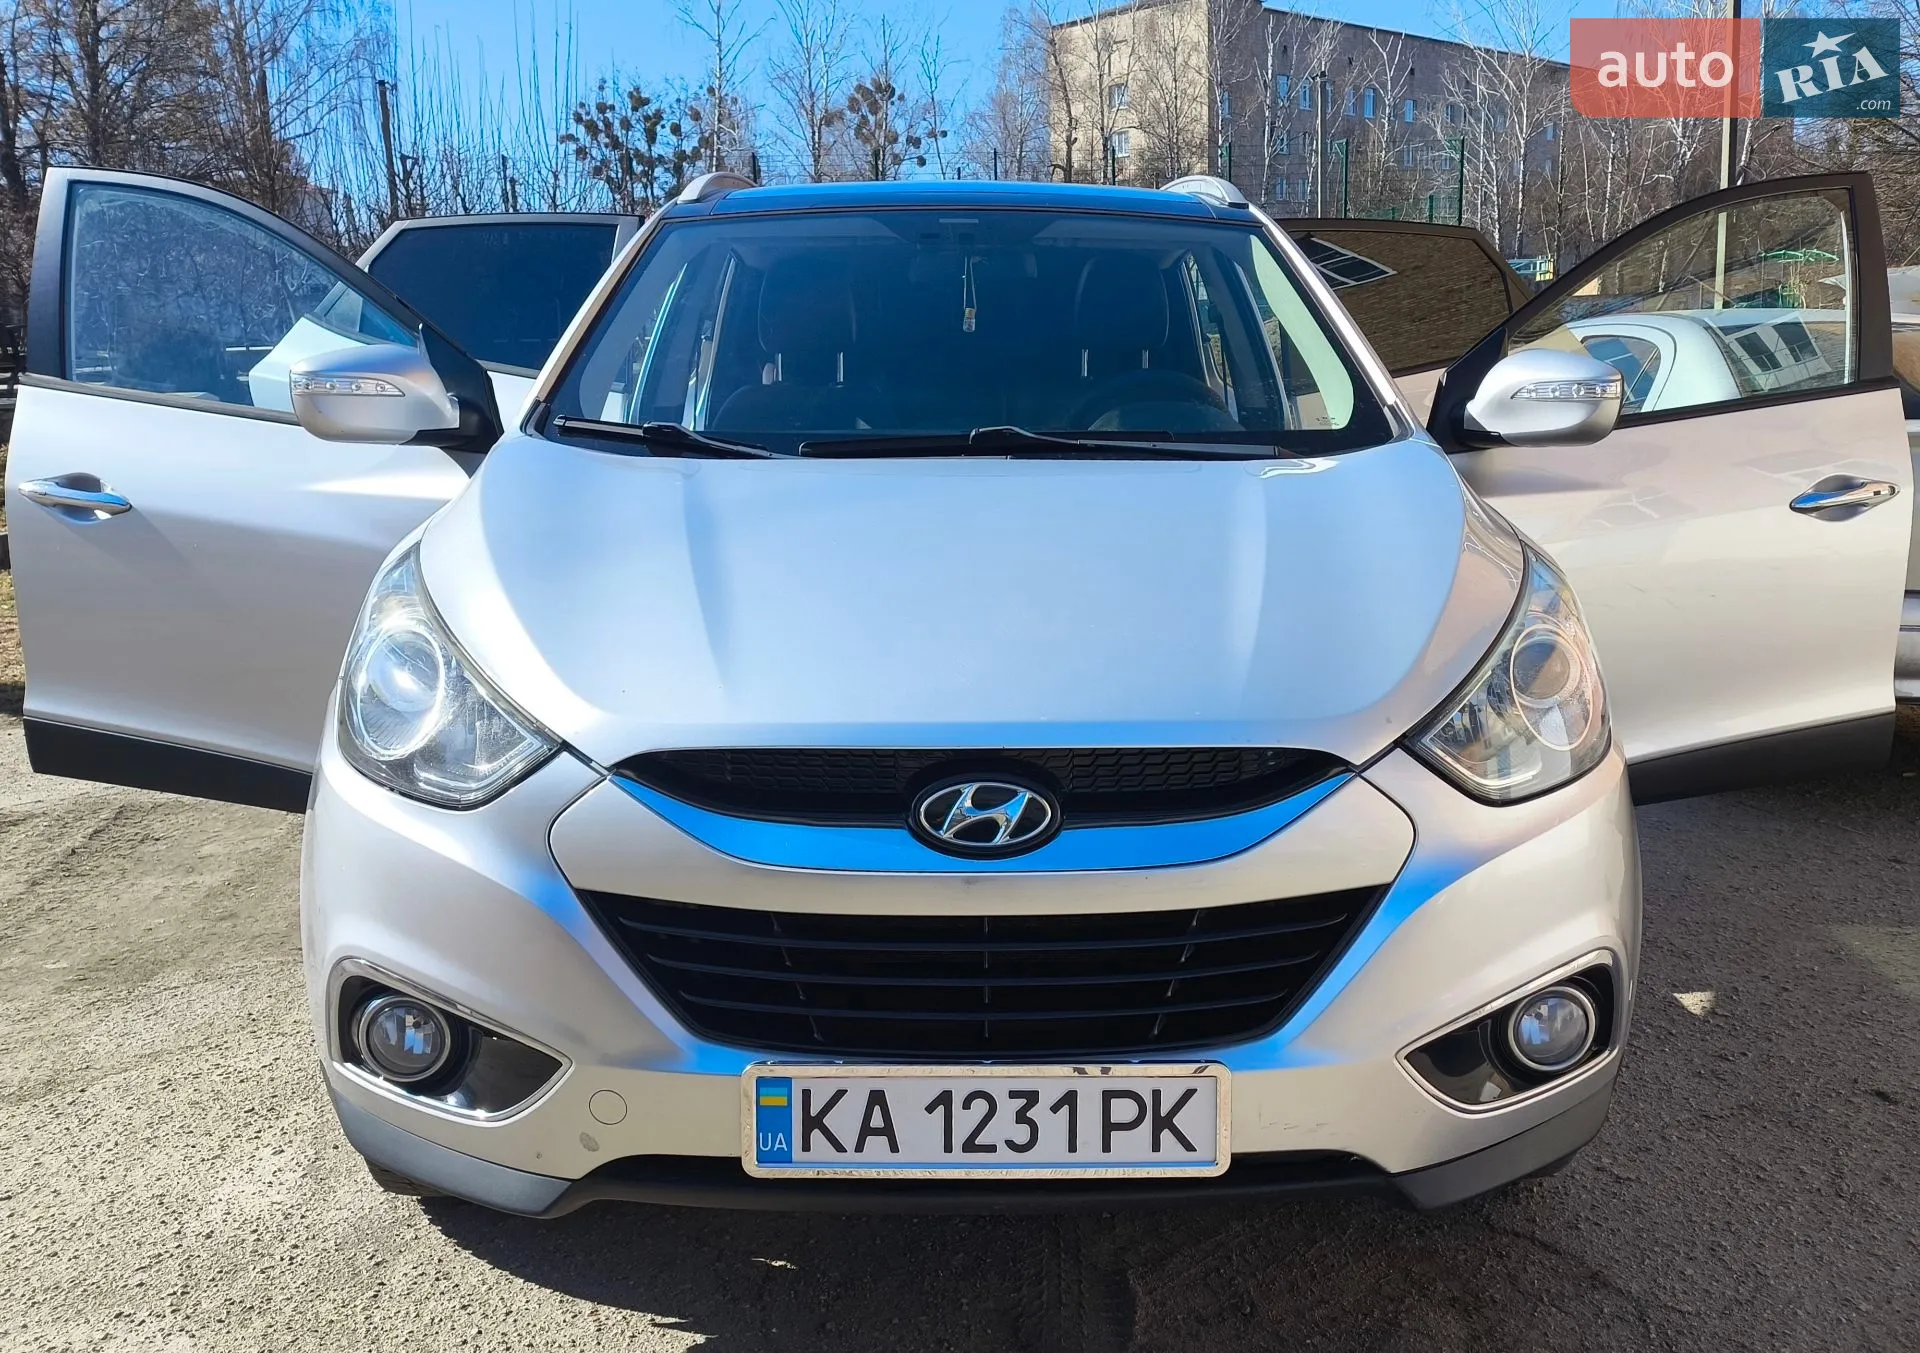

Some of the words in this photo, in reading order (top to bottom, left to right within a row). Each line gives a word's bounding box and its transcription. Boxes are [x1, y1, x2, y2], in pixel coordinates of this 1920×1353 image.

[759, 1132, 788, 1152] UA
[801, 1088, 901, 1154] KA
[924, 1089, 1079, 1154] 1231
[1101, 1088, 1199, 1153] PK
